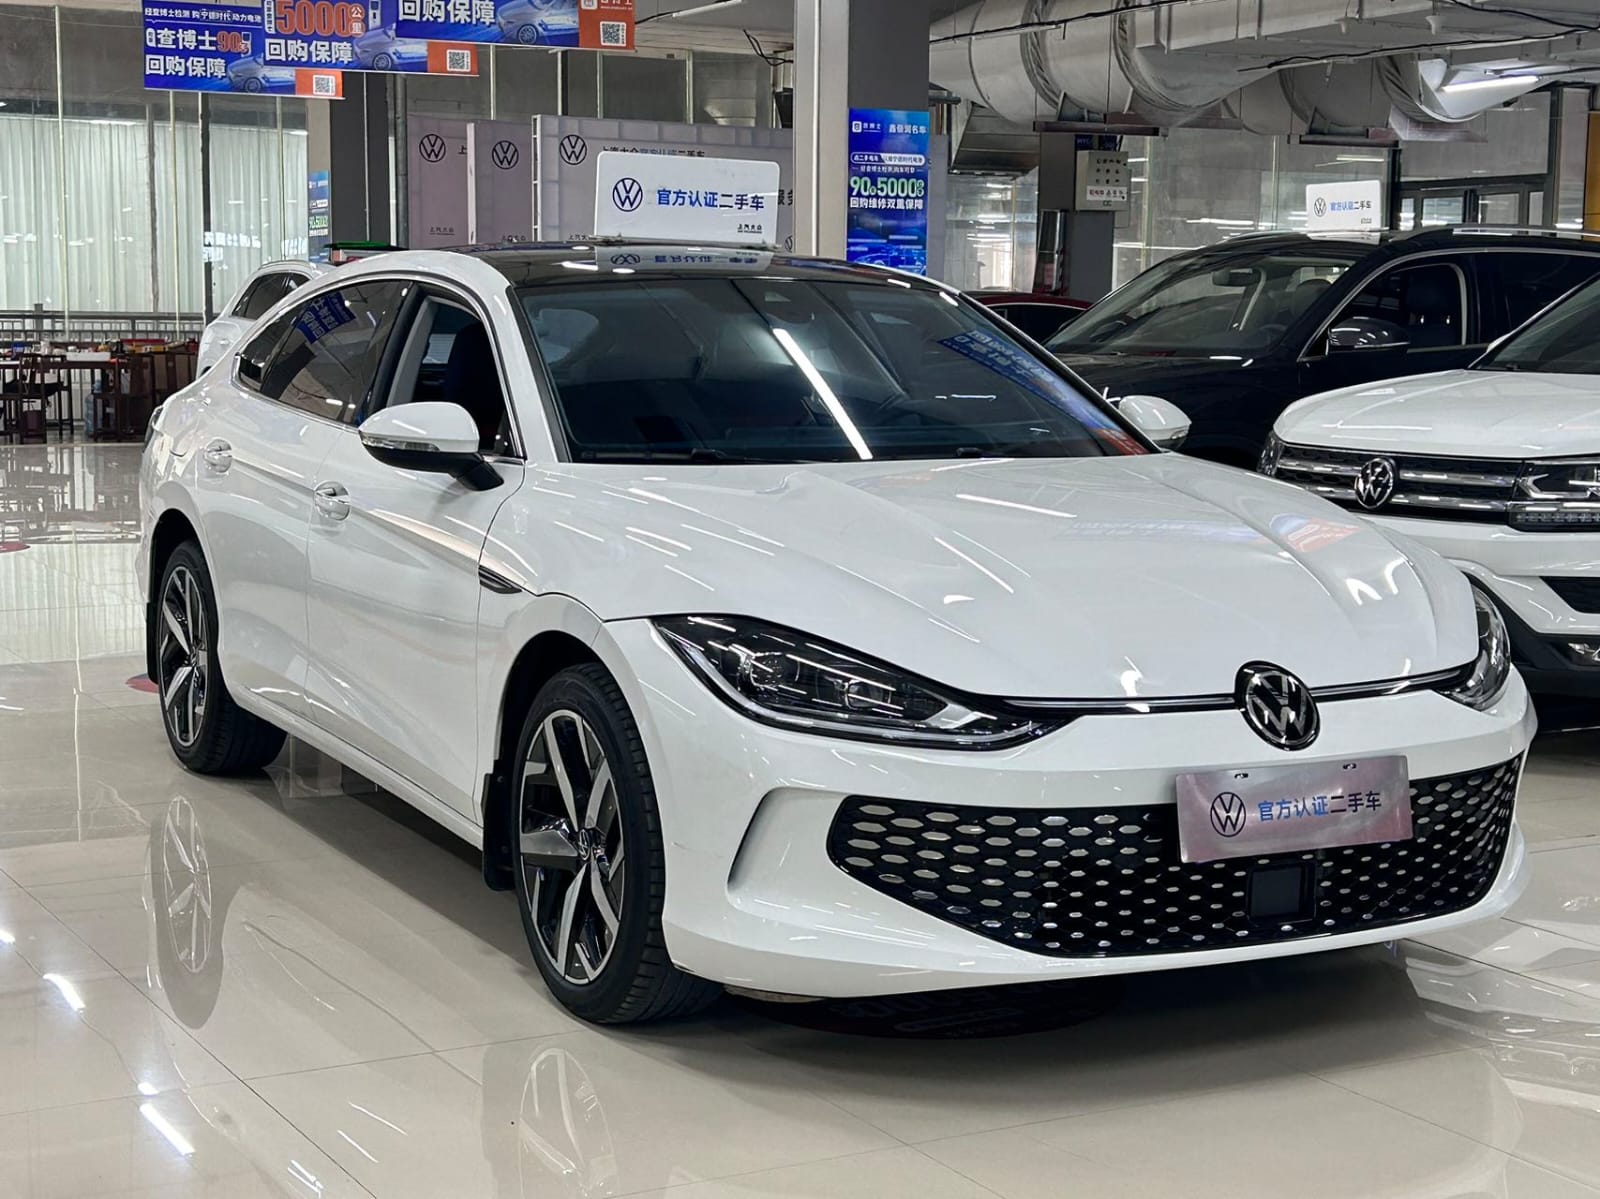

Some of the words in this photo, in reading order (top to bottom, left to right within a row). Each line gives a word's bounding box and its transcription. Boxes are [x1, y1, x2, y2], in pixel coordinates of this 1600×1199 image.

[276, 0, 365, 38] 5000公里
[399, 0, 496, 25] 回购保障
[265, 38, 354, 63] 回购保障
[145, 54, 226, 79] 回购保障
[656, 188, 765, 211] 官方认证二手车
[1257, 790, 1382, 822] 官方认证二手车
